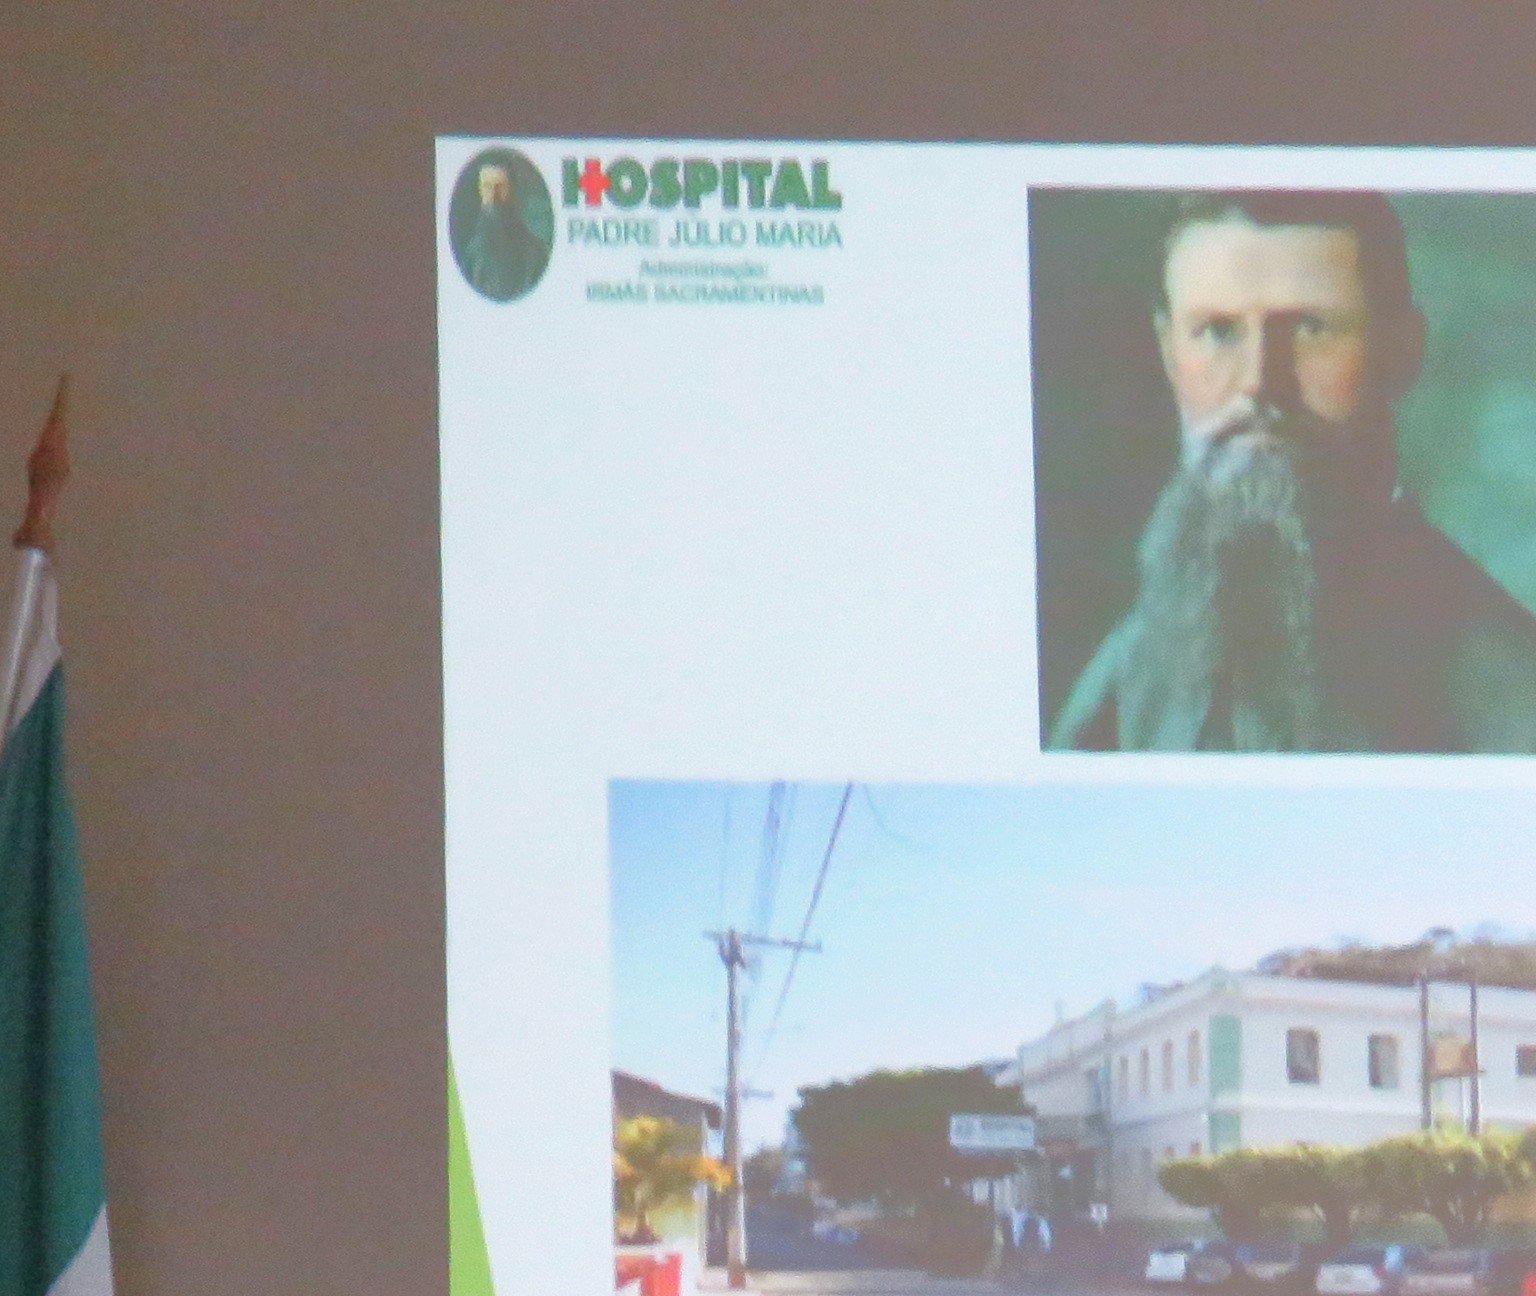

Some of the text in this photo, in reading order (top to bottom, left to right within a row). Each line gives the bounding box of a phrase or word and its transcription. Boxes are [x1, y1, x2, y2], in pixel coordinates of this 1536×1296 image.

[561, 156, 844, 211] HOSPITAL
[567, 217, 658, 247] PADRE
[755, 219, 844, 249] MARIA
[654, 283, 825, 305] SACRAMENTINAS
